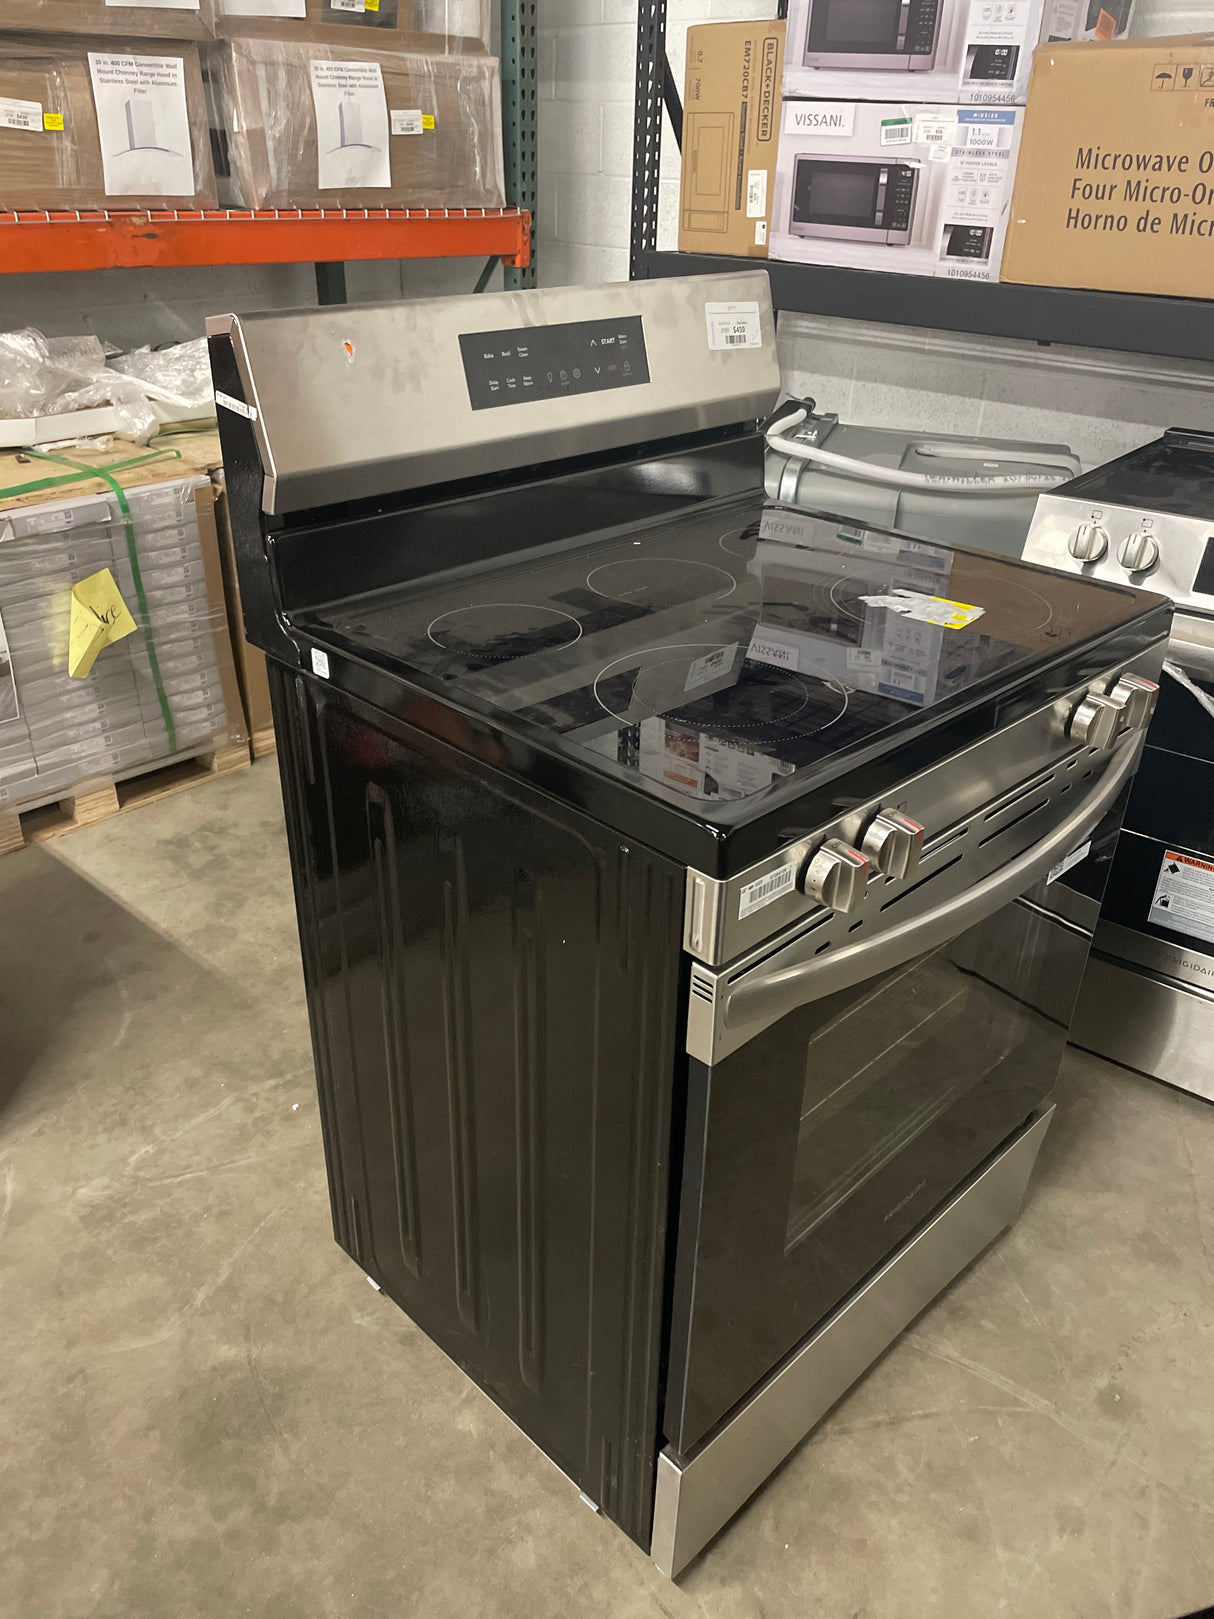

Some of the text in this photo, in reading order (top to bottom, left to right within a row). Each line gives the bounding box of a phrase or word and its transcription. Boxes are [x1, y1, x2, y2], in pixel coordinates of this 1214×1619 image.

[742, 40, 751, 99] EM720CB7
[761, 42, 774, 137] BLACK+DECKER
[970, 93, 1016, 103] 1010954456
[1076, 146, 1190, 172] Microwave
[1070, 178, 1214, 205] Four Micro-Or
[1066, 208, 1214, 236] Horno de Micr
[948, 268, 990, 280] 1010954456
